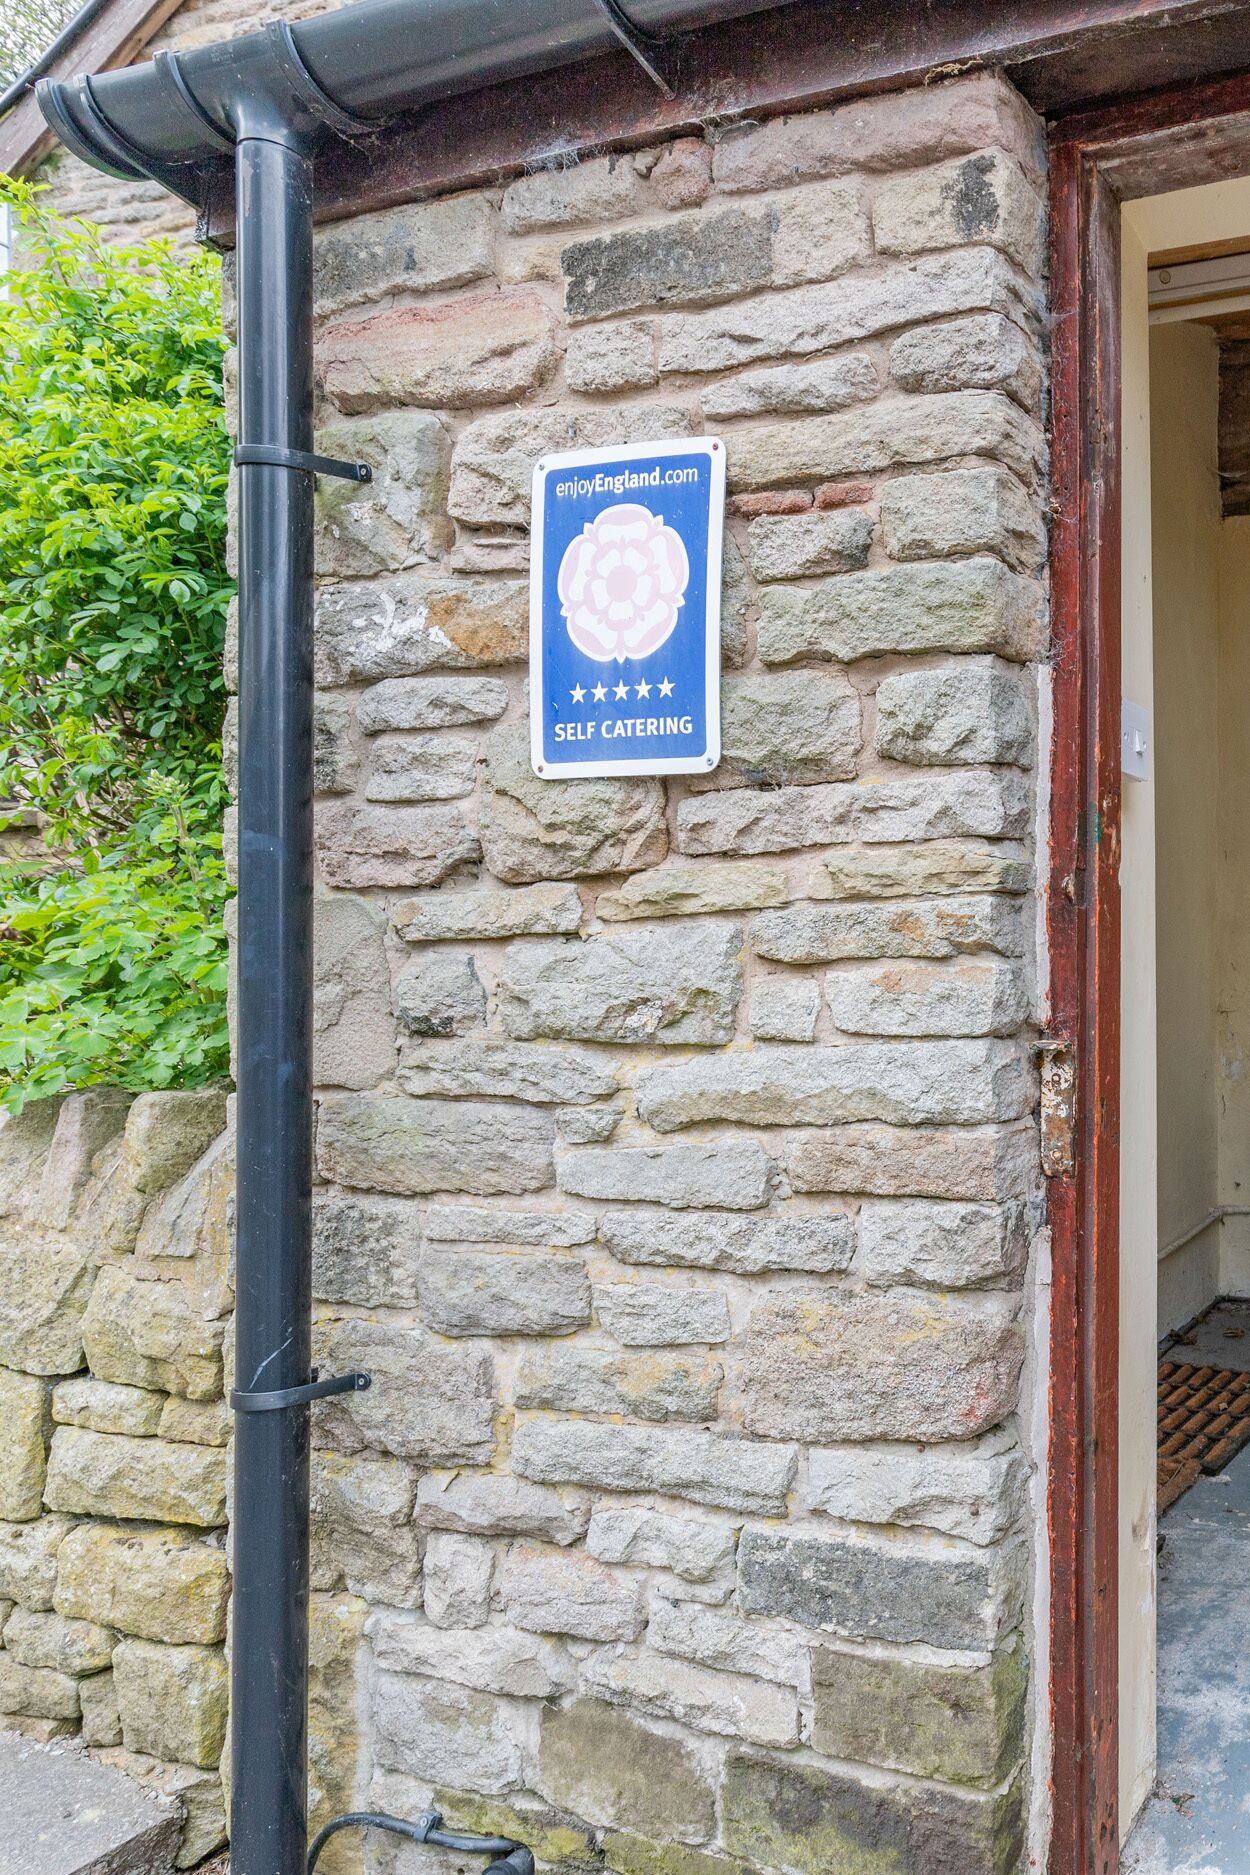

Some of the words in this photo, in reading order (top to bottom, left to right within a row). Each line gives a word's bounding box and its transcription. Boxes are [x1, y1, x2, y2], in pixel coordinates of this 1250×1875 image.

[555, 467, 698, 498] enjoyEngland.com
[554, 721, 596, 742] SELF
[601, 716, 693, 738] CATERING
